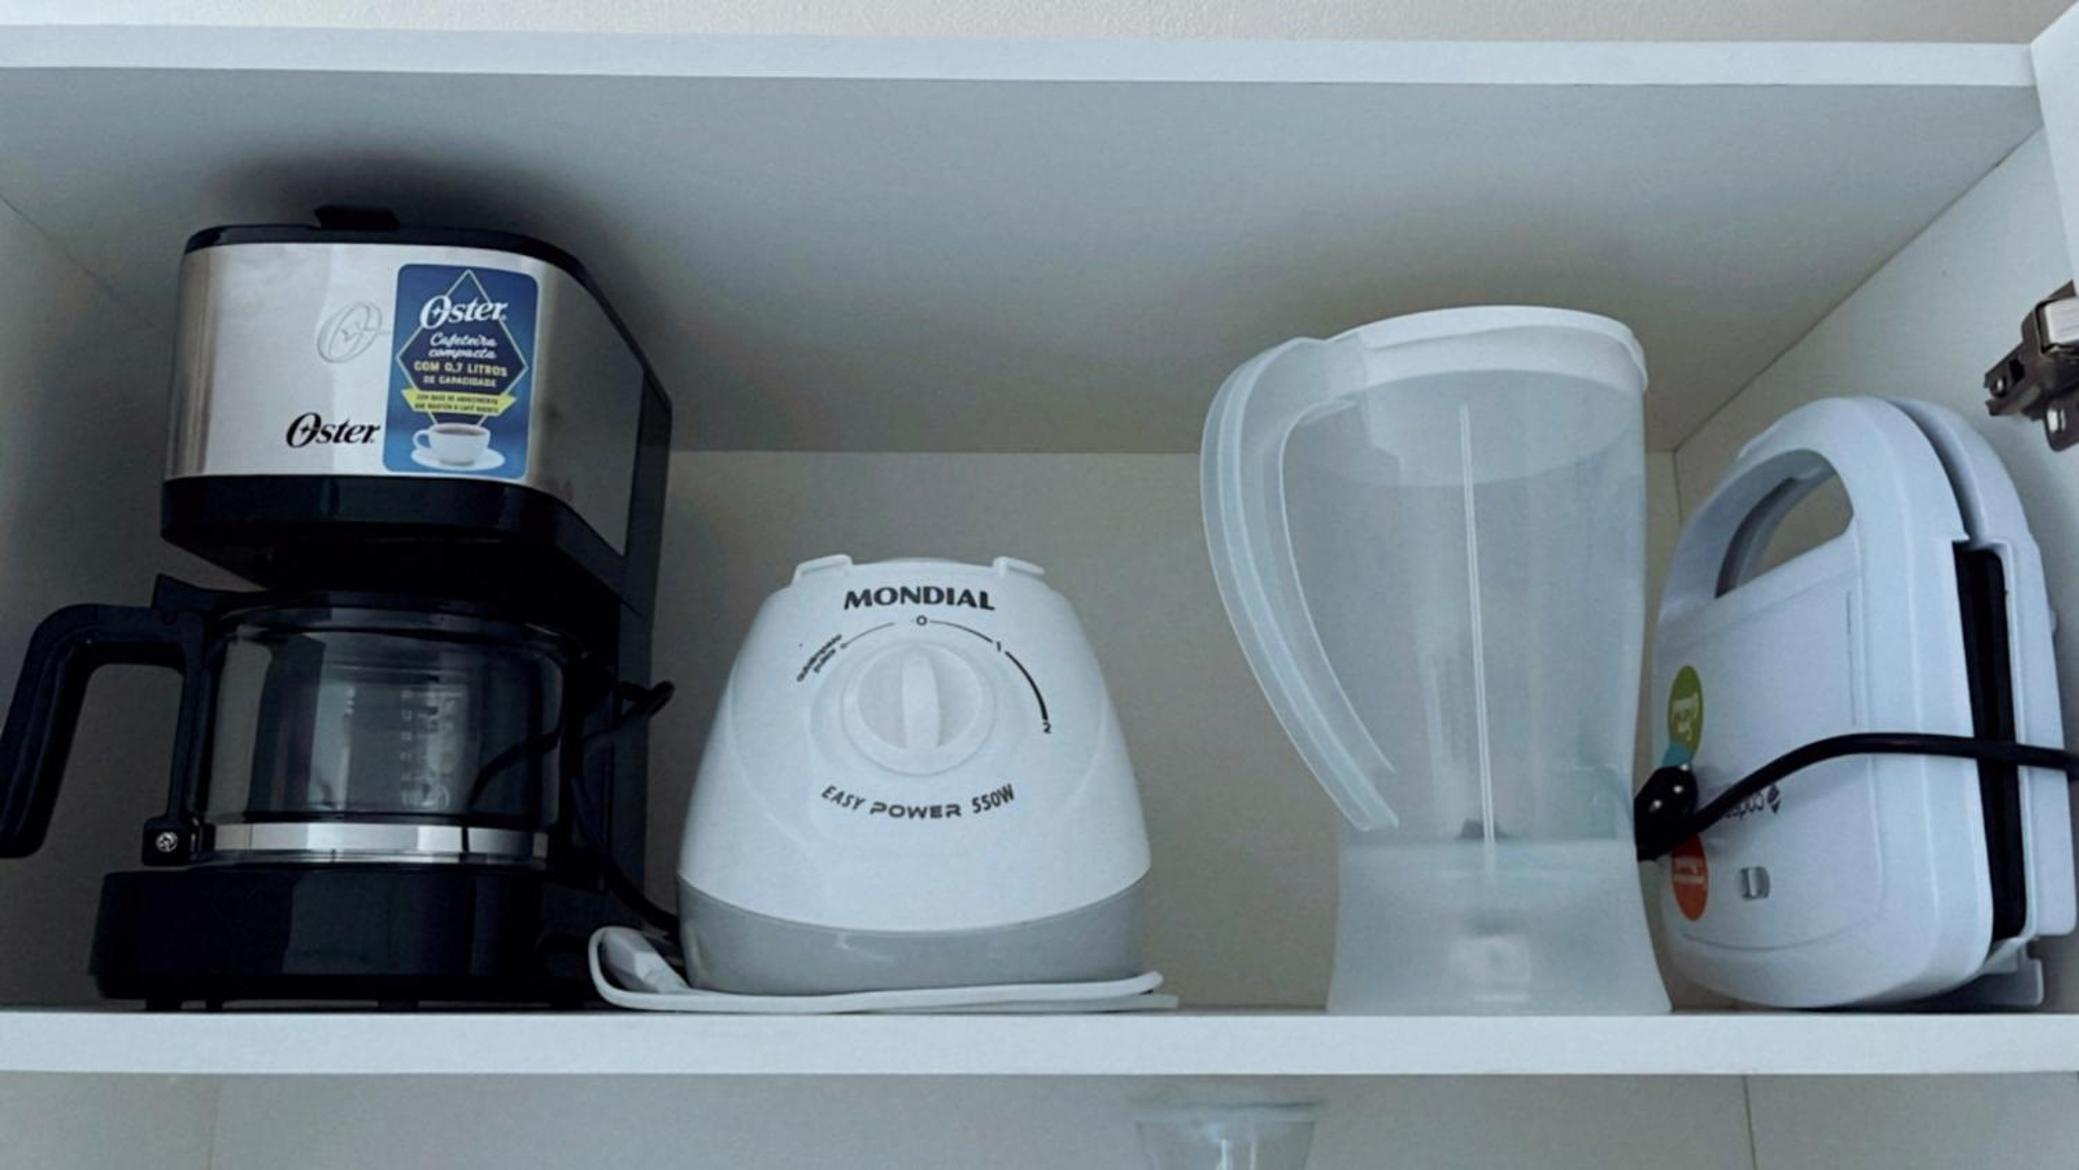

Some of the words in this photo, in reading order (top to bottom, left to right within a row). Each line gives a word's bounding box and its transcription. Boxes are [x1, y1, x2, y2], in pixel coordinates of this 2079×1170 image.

[420, 295, 508, 329] Oster
[430, 332, 497, 348] Cafeteira
[414, 360, 441, 372] COM
[467, 363, 508, 377] LITROS
[423, 375, 435, 384] DE
[287, 412, 380, 448] Oster
[843, 586, 995, 612] MONDIAL
[1042, 721, 1052, 734] 2
[821, 785, 867, 811] EASY
[869, 801, 962, 819] POWER
[971, 783, 1016, 814] 550W
